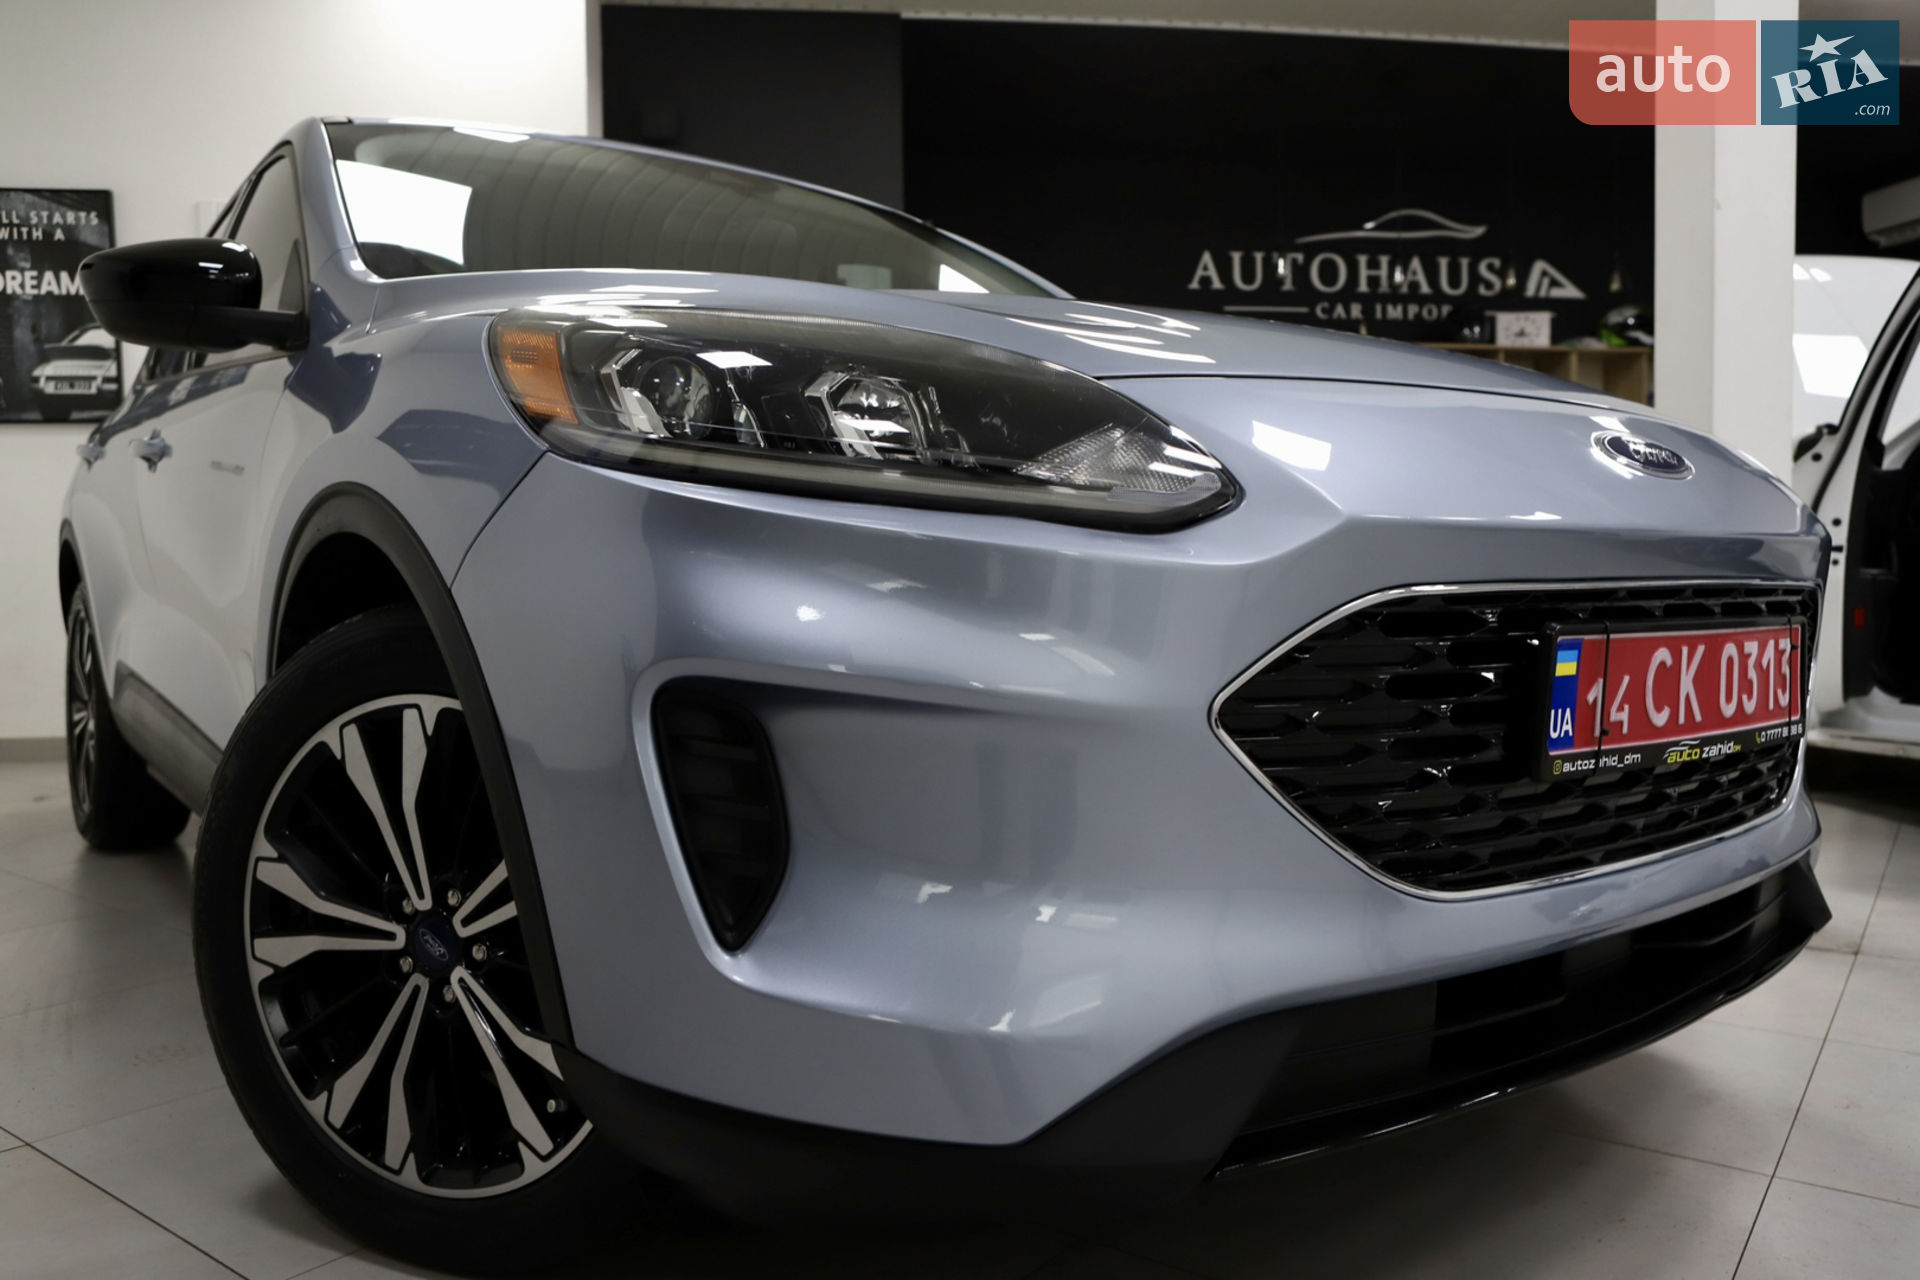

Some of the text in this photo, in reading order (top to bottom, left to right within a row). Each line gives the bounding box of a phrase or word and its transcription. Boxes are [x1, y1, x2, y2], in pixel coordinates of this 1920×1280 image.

[0, 210, 99, 226] LL STARTS
[54, 227, 66, 242] A
[0, 269, 85, 296] REAM
[1188, 250, 1503, 297] AUTOHAUS
[1315, 302, 1453, 321] CAR IMPO
[1586, 637, 1791, 738] 14 CK 0313
[1549, 707, 1573, 739] UA
